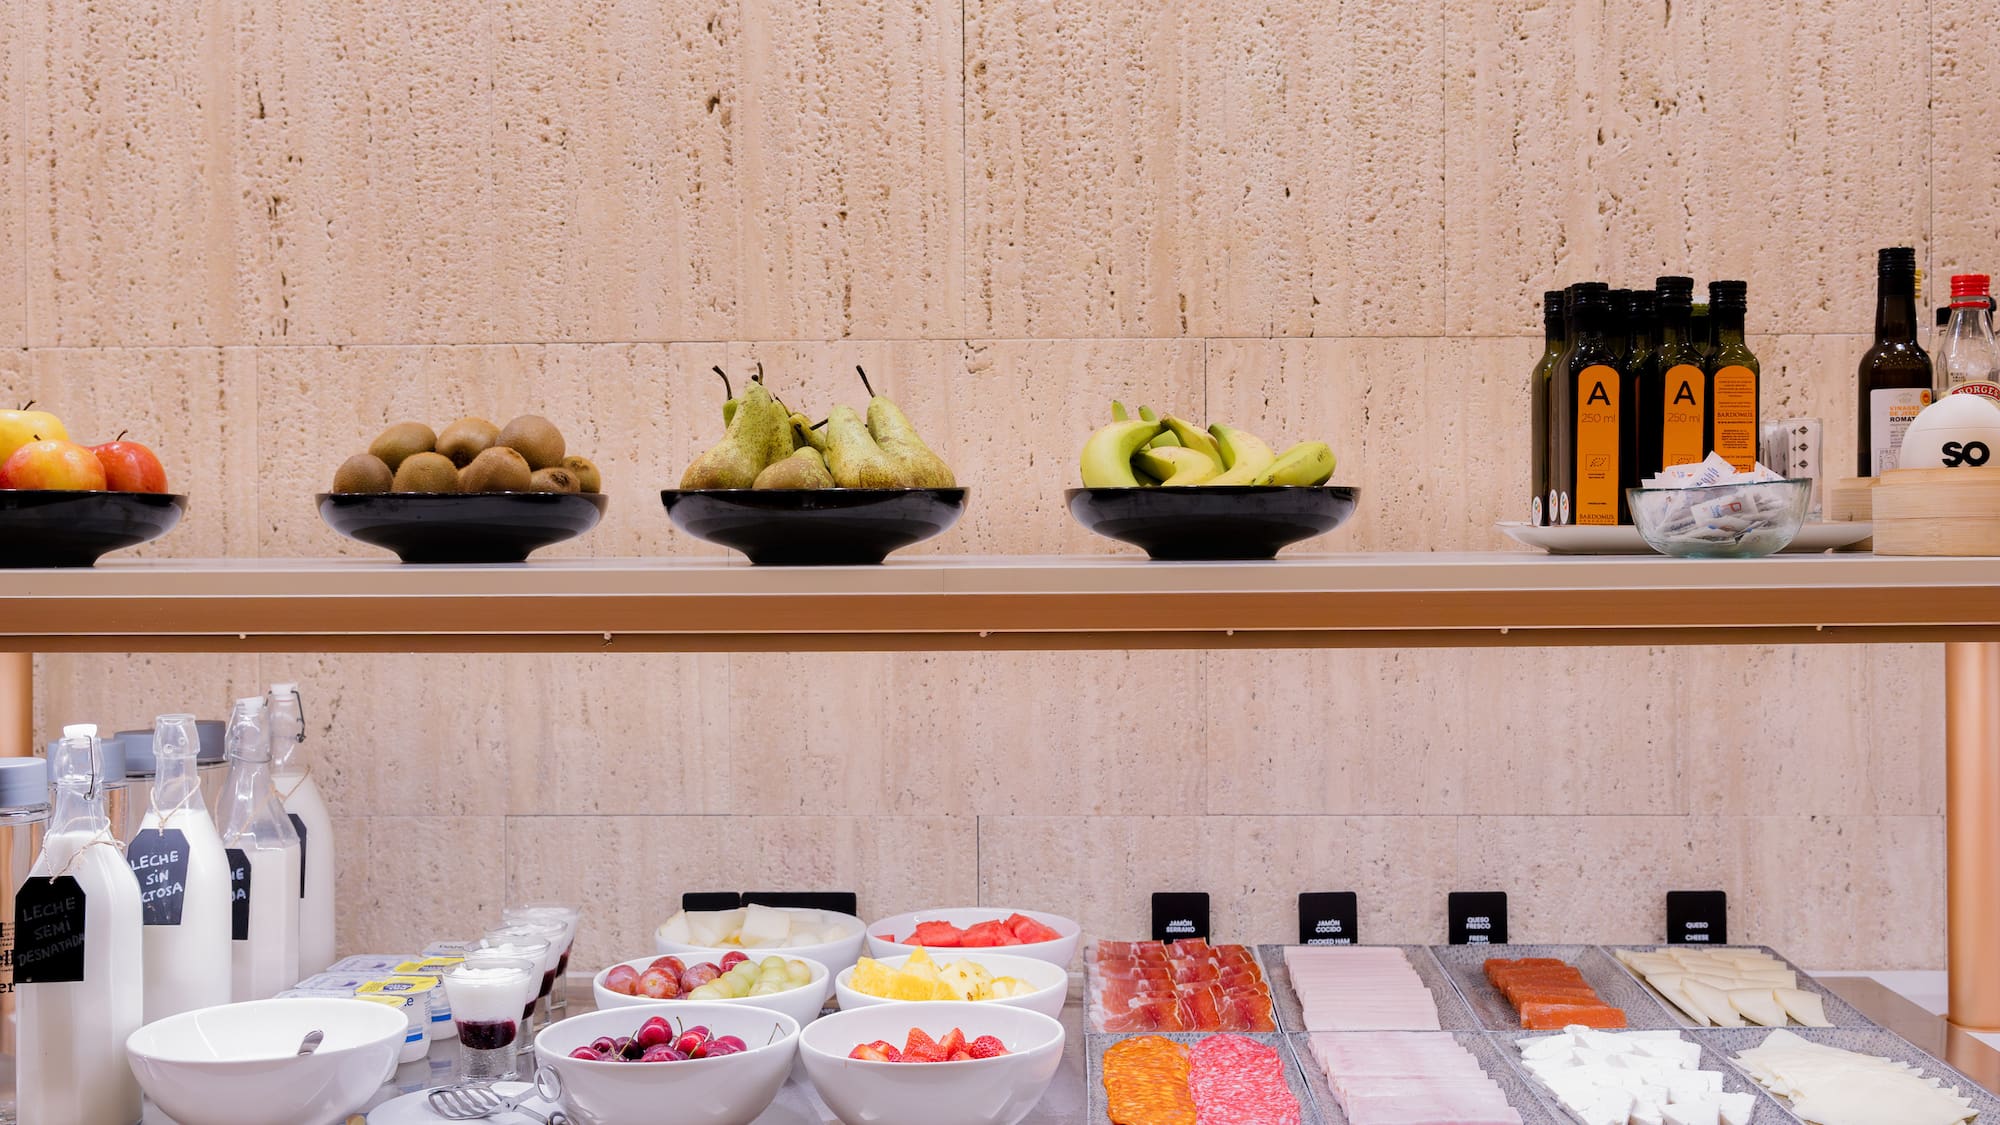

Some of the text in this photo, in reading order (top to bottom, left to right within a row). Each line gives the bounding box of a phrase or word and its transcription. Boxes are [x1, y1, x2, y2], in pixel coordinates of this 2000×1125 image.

[1586, 381, 1611, 406] A
[1673, 380, 1696, 405] A
[1581, 413, 1616, 423] 250 ml
[1667, 413, 1687, 423] 250
[1942, 441, 1990, 467] SO
[131, 850, 179, 871] LECHE
[23, 897, 76, 921] LECHE
[1169, 919, 1193, 927] JAMÓN
[1317, 919, 1341, 927] JAMÓN
[1685, 921, 1709, 929] QUESO
